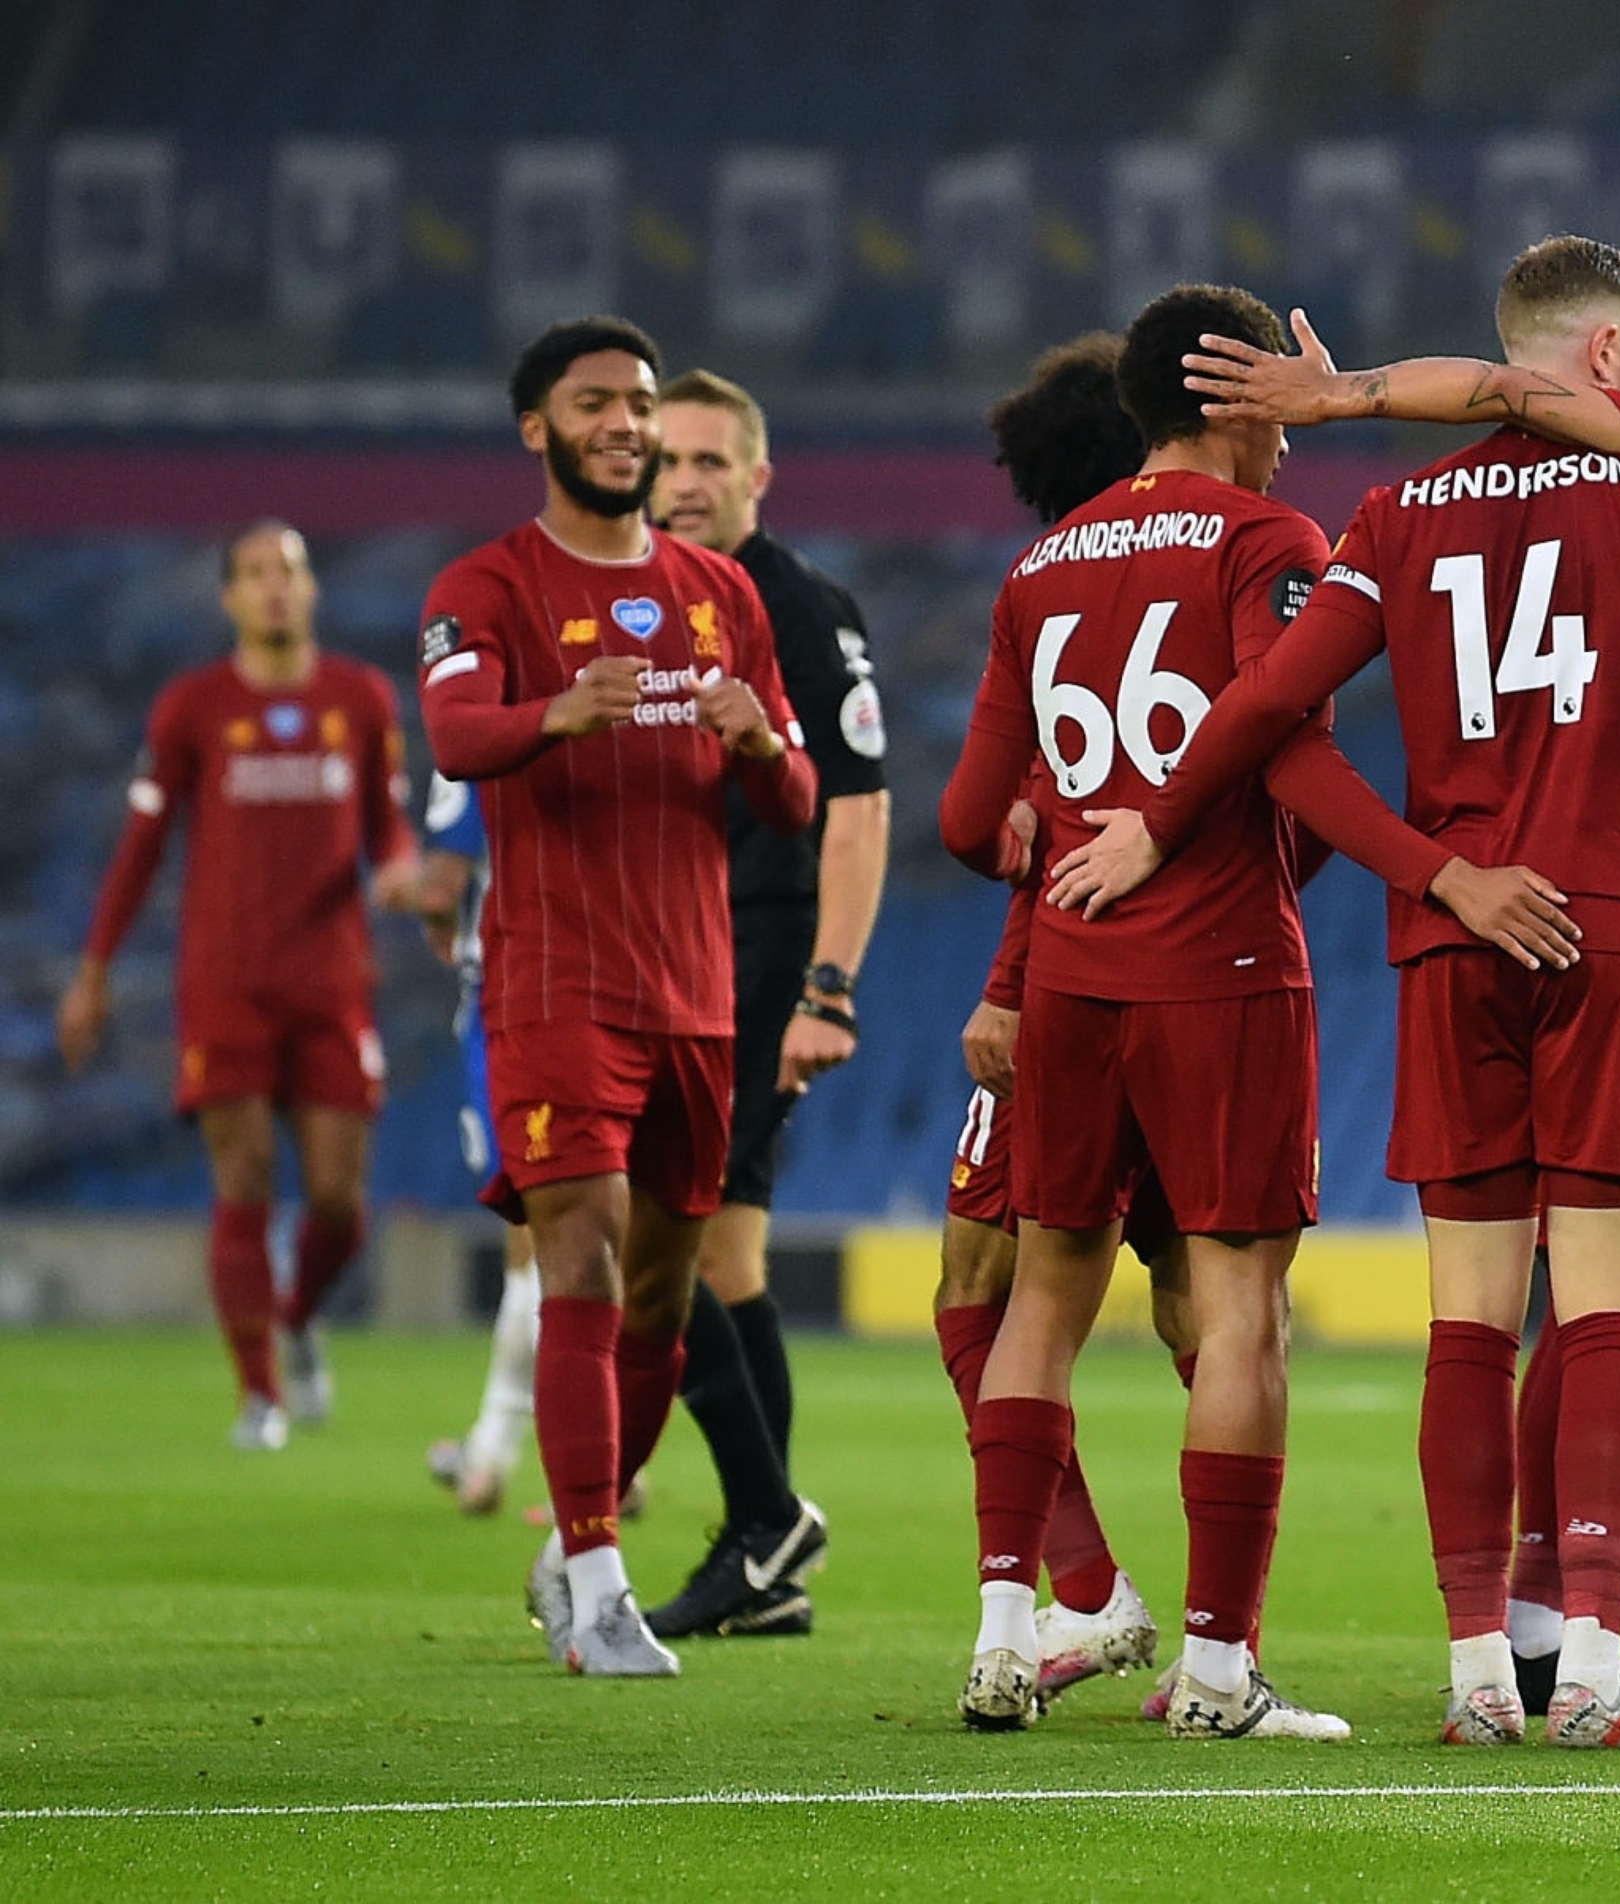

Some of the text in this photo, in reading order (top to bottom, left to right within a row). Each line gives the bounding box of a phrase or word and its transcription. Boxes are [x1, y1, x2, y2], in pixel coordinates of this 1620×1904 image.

[1012, 511, 1224, 579] ALEXANDER-ARNOLD
[1430, 539, 1598, 739] 14
[1032, 601, 1212, 798] 66
